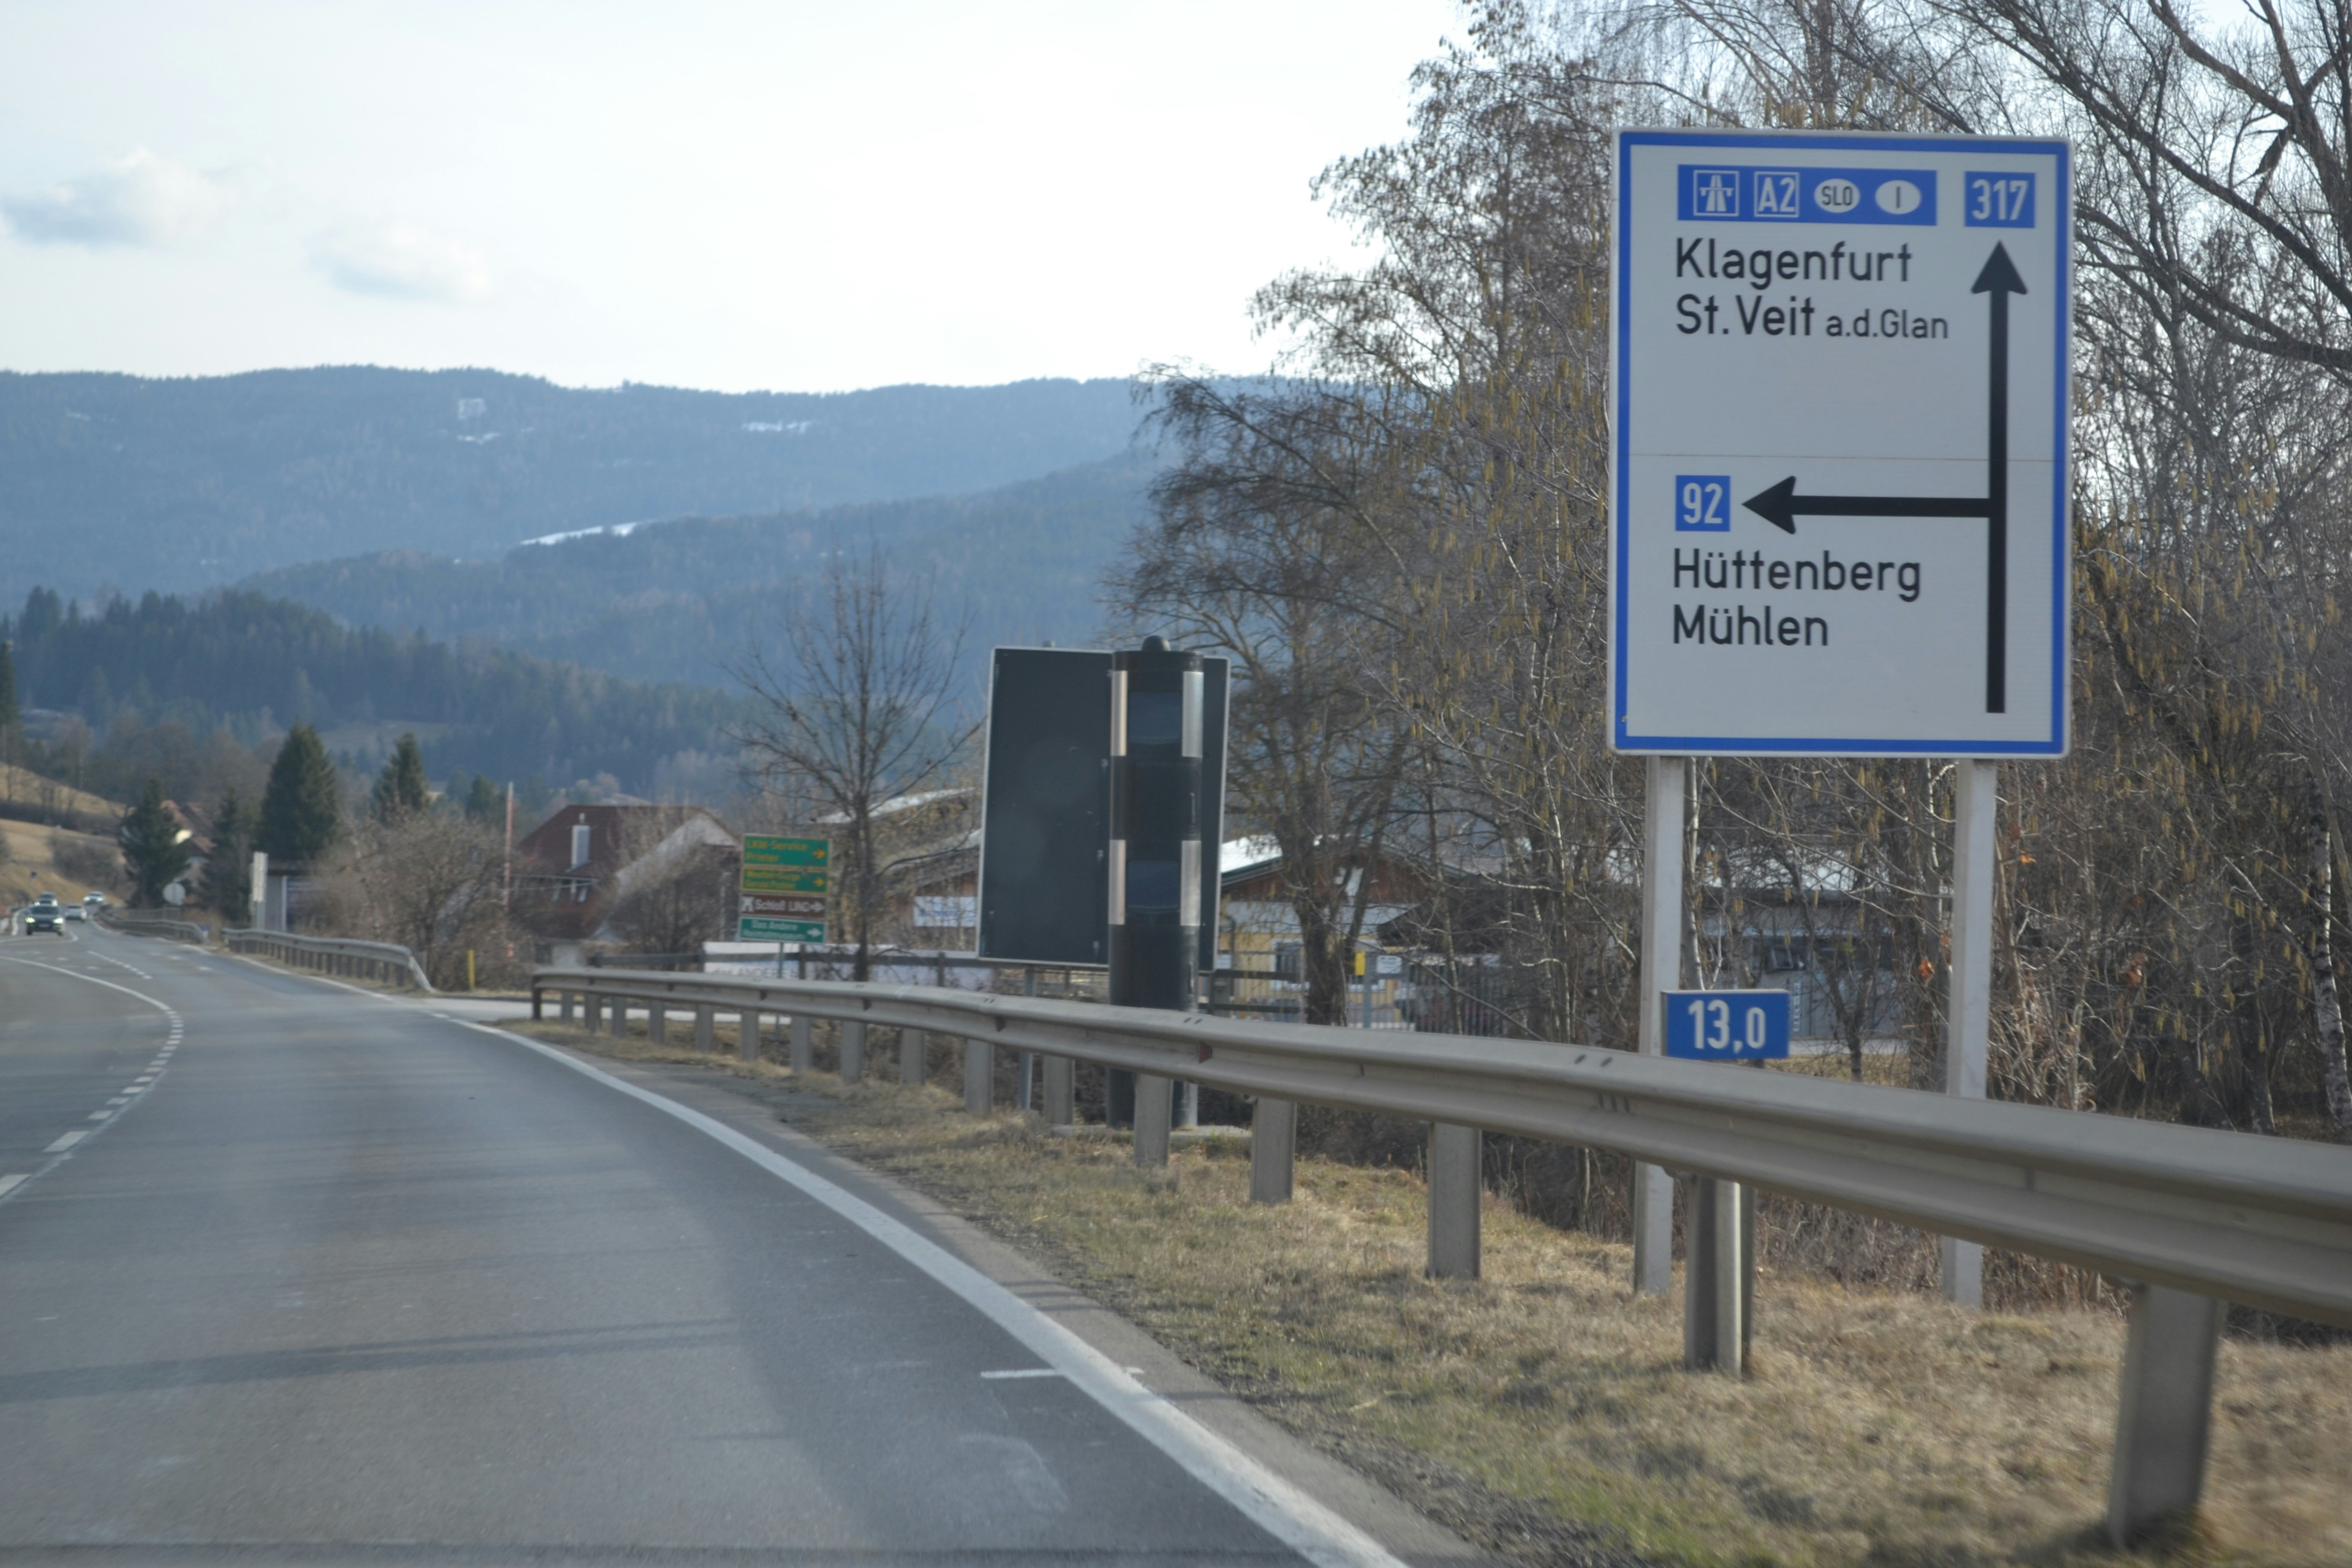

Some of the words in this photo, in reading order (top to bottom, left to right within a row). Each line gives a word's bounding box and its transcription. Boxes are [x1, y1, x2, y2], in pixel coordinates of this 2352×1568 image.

[1758, 177, 1796, 213] A2
[1821, 186, 1854, 207] SLO
[1895, 186, 1901, 208] I
[1972, 179, 2029, 220] 317
[1676, 237, 1913, 290] Klagenfurt
[1825, 308, 1949, 339] a.d.Glan
[1683, 482, 1723, 525] 92
[1673, 548, 1921, 603] Hüttenberg
[1673, 604, 1829, 646] Mühlen
[1688, 999, 1766, 1055] 13,0
